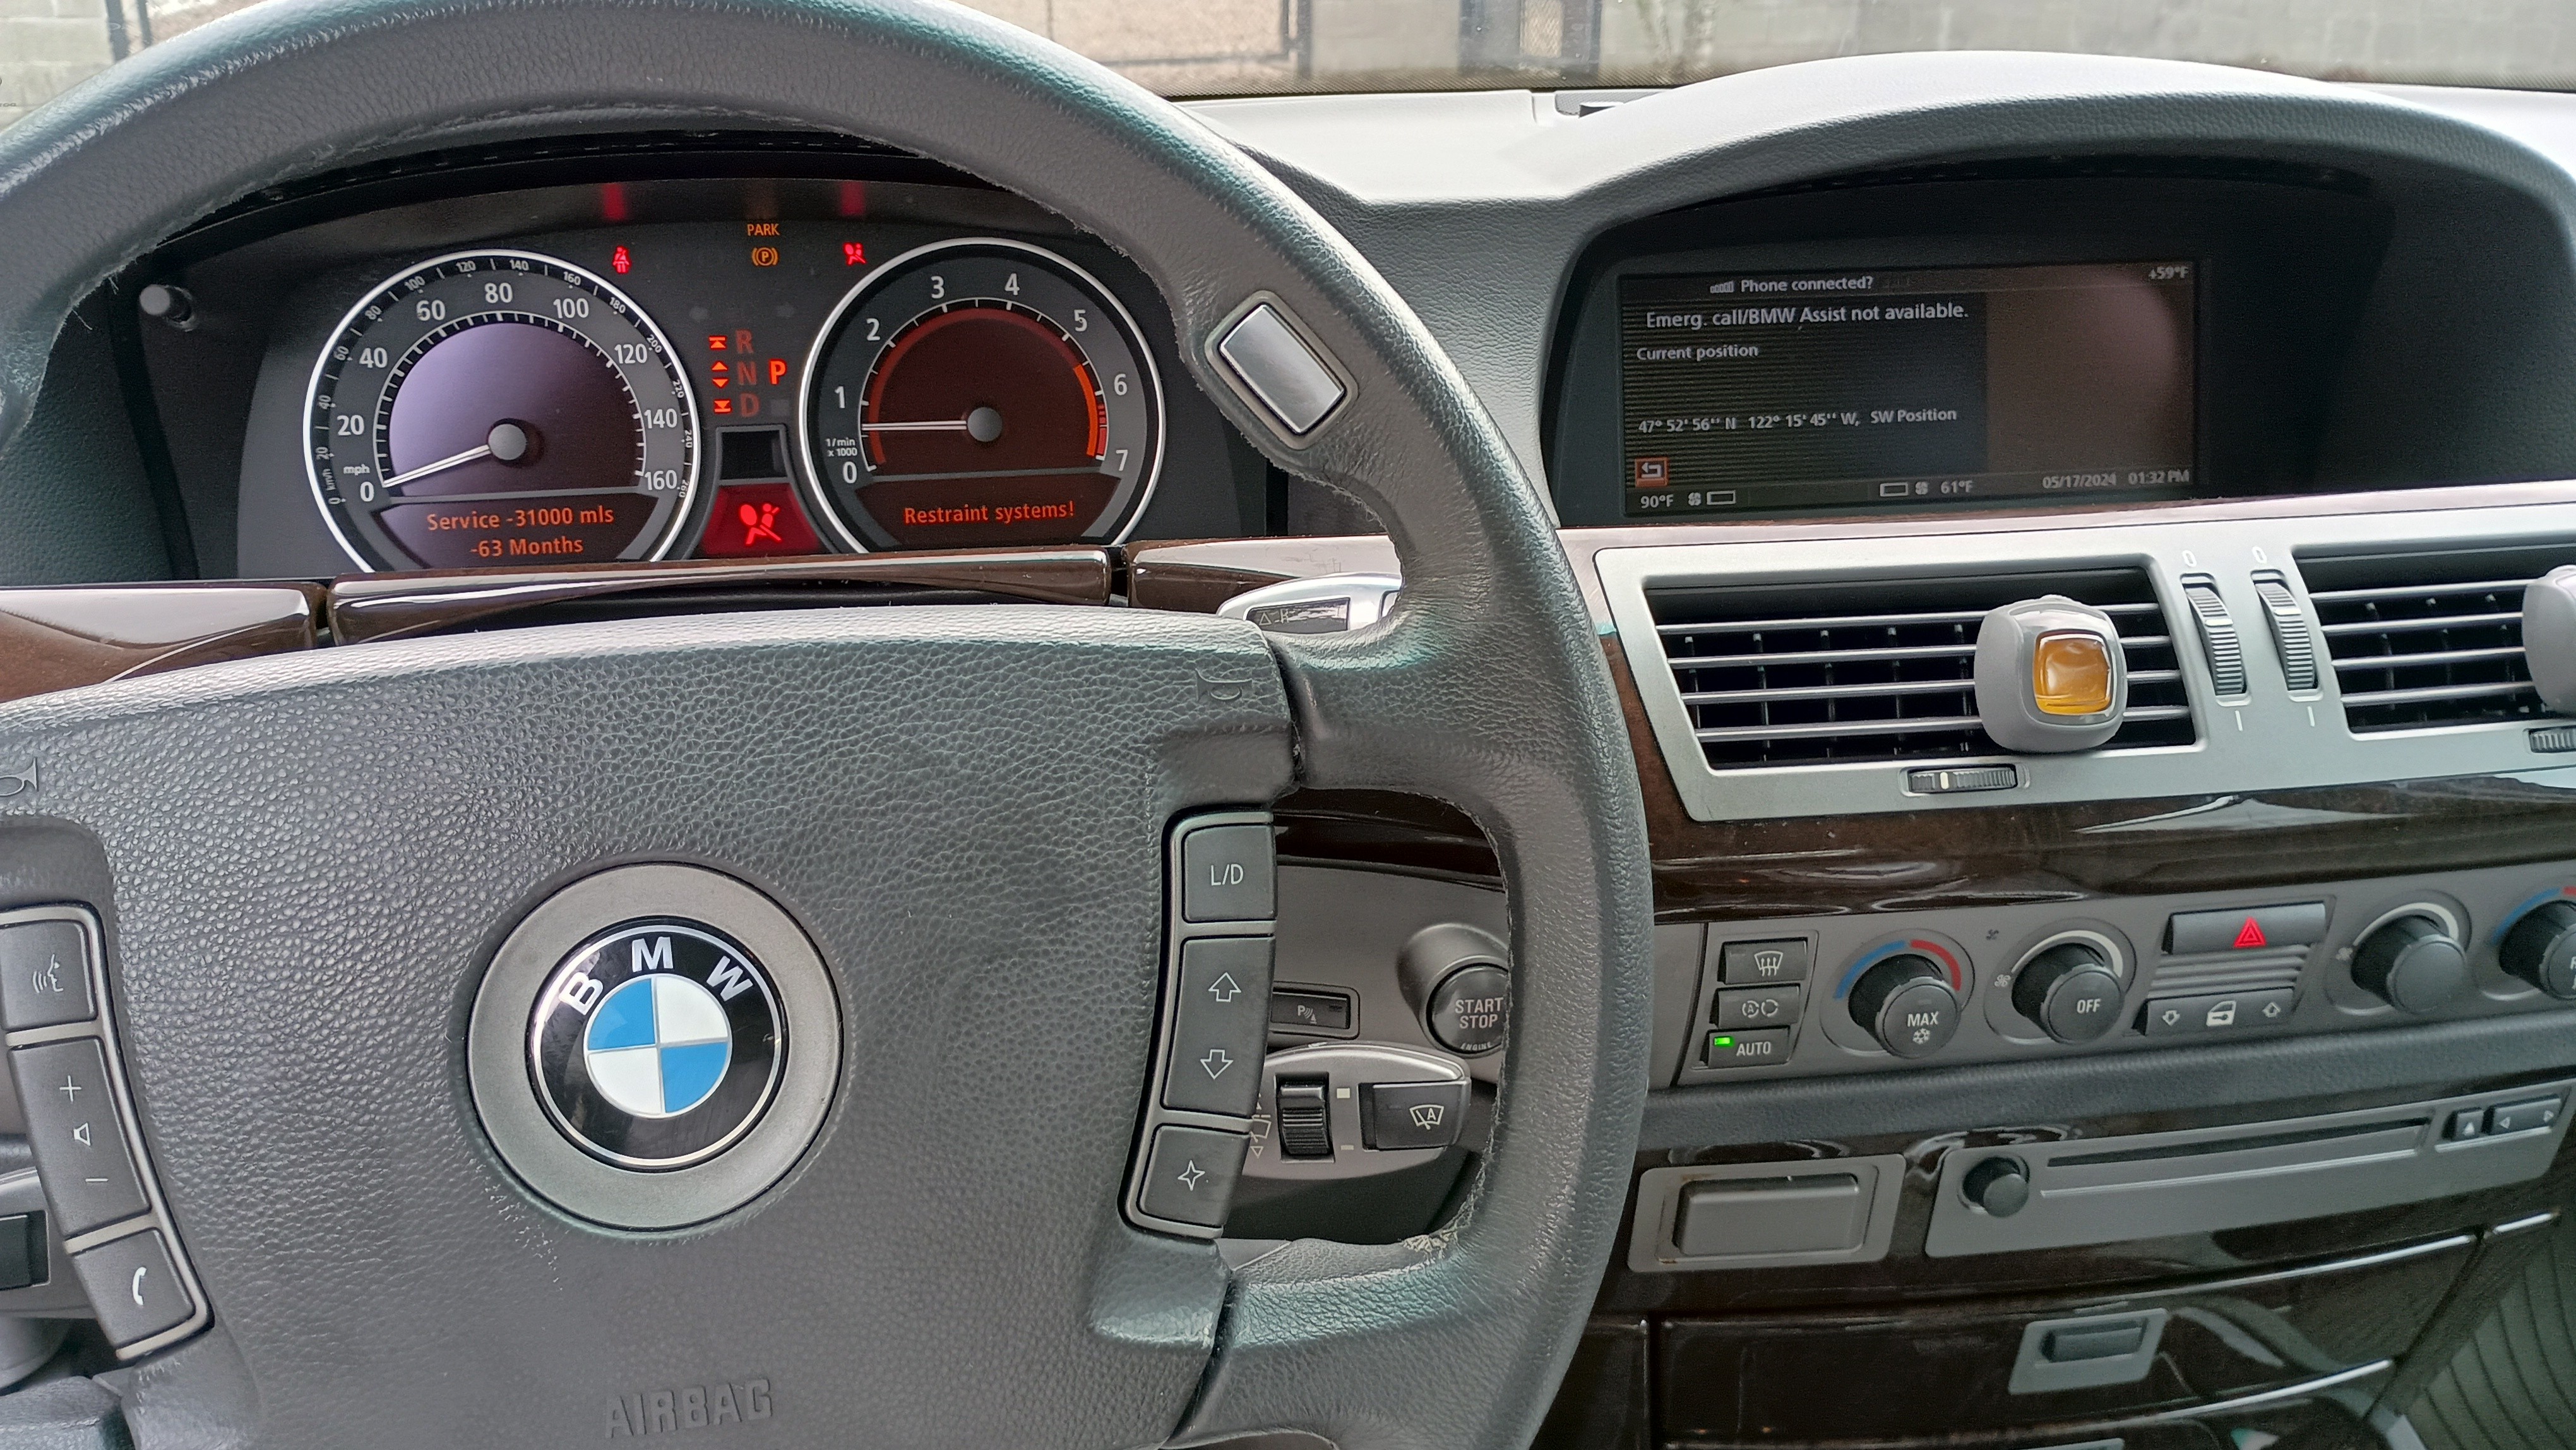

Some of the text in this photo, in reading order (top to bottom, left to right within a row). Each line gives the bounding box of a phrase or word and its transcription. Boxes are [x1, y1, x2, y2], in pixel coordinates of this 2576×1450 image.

[747, 224, 780, 236] PARK
[456, 260, 477, 273] 120
[510, 259, 529, 271] 140
[404, 275, 426, 291] 100
[563, 271, 581, 286] 160
[931, 275, 945, 299] 3
[1005, 273, 1020, 296] 4
[1741, 276, 1873, 292] Phone connected?
[484, 282, 514, 304] 80
[364, 305, 383, 320] 80
[415, 299, 446, 321] 60
[553, 297, 590, 319] 100
[609, 296, 626, 315] 180
[1074, 309, 1087, 332] 5
[1646, 303, 1969, 330] Emerg. call/BMW Assist not available.
[866, 318, 881, 341] 2
[646, 334, 663, 354] 200
[735, 329, 754, 354] R
[333, 345, 349, 361] 60
[359, 347, 388, 368] 40
[614, 343, 648, 364] 120
[1636, 344, 1759, 362] Current position
[737, 359, 787, 385] N P
[673, 379, 685, 398] 220
[1114, 373, 1128, 396] 6
[318, 395, 331, 410] 40
[740, 393, 760, 417] D
[835, 386, 845, 409] 1
[337, 414, 365, 436] 20
[644, 408, 678, 429] 140
[1725, 417, 1737, 430] N
[1870, 410, 1894, 424] SW
[1897, 407, 1957, 422] Position
[684, 429, 693, 448] 240
[826, 437, 856, 447] 1/min
[315, 446, 329, 460] 20
[837, 447, 858, 457] 1000
[1116, 449, 1129, 472] 7
[343, 464, 370, 476] mph
[644, 470, 678, 491] 160
[842, 461, 857, 484] 0
[2042, 469, 2190, 489] 05/17/2024 01:32 PM
[360, 481, 375, 502] 0
[678, 479, 689, 498] 260
[1940, 480, 1973, 494] 61°F
[1640, 494, 1674, 508] 90°F
[426, 505, 614, 530] Service -31000 mls
[904, 501, 1074, 524] Restraint systems!
[470, 536, 584, 558] -63 Months
[1211, 864, 1244, 886] L/D
[558, 936, 754, 1016] BMW
[1455, 997, 1504, 1014] START
[2077, 998, 2101, 1014] OFF
[1459, 1014, 1498, 1029] STOP
[1907, 1012, 1939, 1027] MAX
[1736, 1041, 1771, 1057] AUTO
[605, 1378, 773, 1439] AIRBAG
